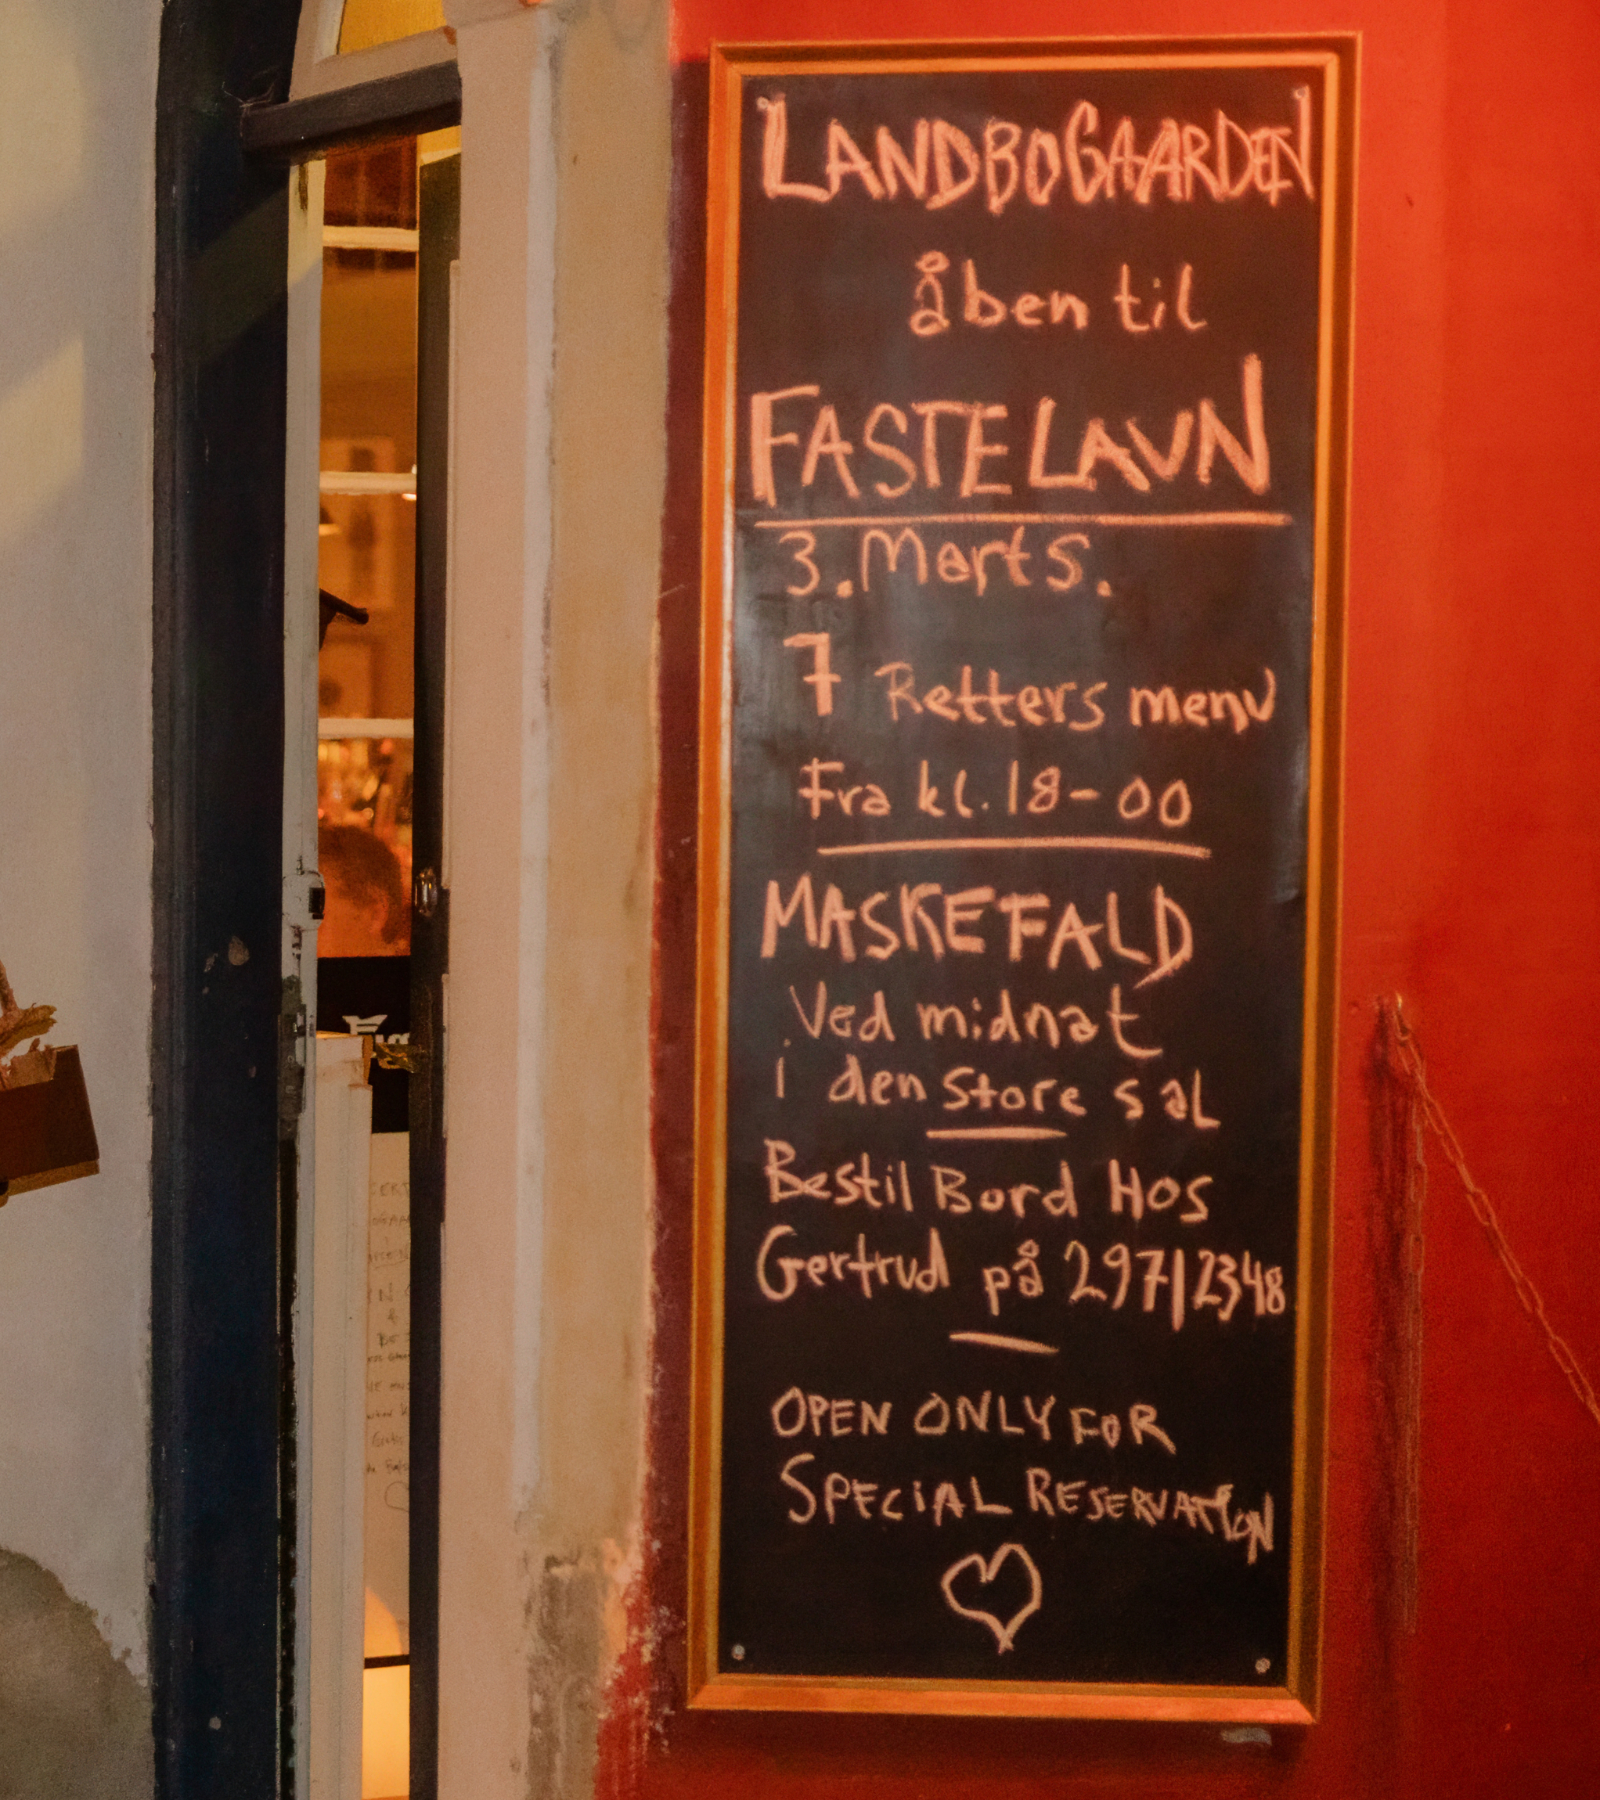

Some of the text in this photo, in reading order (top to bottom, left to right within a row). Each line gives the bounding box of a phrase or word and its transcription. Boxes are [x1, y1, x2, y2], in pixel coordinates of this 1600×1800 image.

[909, 251, 1207, 337] åben til
[752, 353, 1270, 507] FASTELAVN
[784, 633, 841, 716] 7
[875, 662, 1107, 731] Retters
[799, 758, 890, 819] Fra
[761, 873, 1193, 990] MASKEFALD
[790, 981, 1163, 1059] Ved midnat
[775, 1038, 790, 1098] i
[829, 1054, 927, 1105] den
[764, 1138, 913, 1212] Bestil
[930, 1161, 1078, 1218] Bord
[756, 1224, 950, 1302] Gertrud
[983, 1239, 1044, 1316] på
[771, 1386, 1176, 1454] OPEN ONLY FOR
